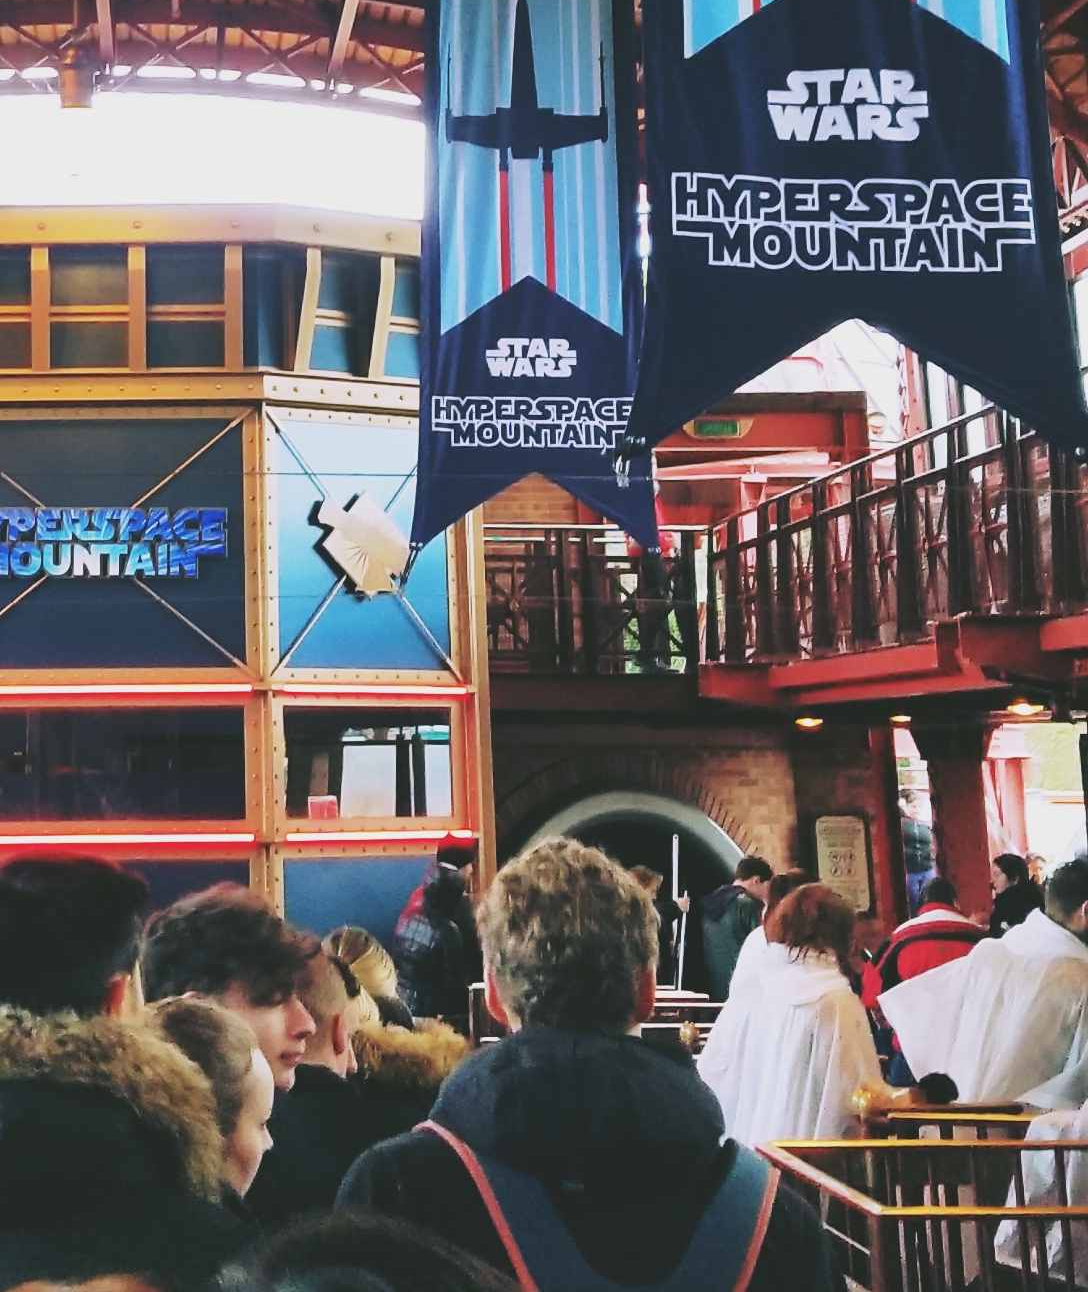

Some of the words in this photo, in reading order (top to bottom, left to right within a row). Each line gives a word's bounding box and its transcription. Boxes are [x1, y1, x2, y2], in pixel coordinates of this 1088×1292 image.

[767, 68, 928, 105] STAR
[768, 104, 928, 141] WARS
[672, 172, 1034, 225] HYPERSPACE
[672, 219, 1036, 273] MOUNTAIN
[485, 337, 577, 358] STAR
[486, 357, 577, 378] WARS
[432, 396, 634, 423] HYPERSPACE
[432, 420, 628, 448] MOUNTAIN
